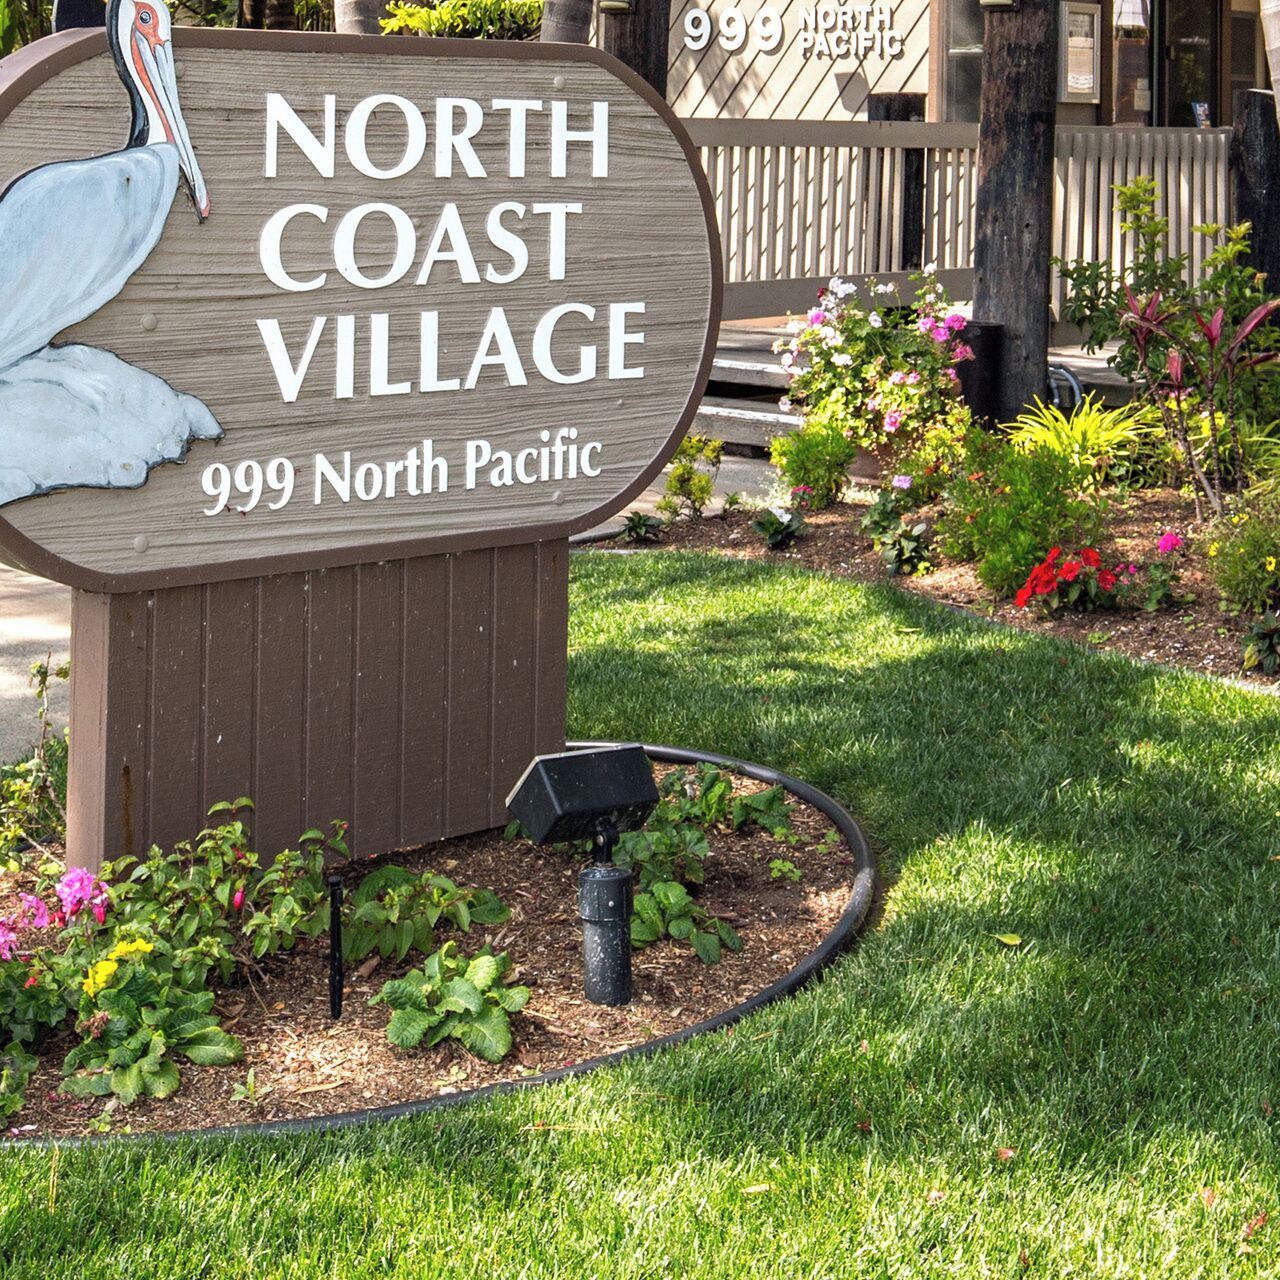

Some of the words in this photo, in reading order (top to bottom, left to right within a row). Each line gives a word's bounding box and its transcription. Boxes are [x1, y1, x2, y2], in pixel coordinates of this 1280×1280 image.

[683, 7, 782, 51] 999
[799, 7, 891, 29] NORTH
[800, 30, 902, 55] PACIFIC
[264, 93, 609, 180] NORTH
[258, 202, 583, 292] COAST
[255, 301, 646, 403] VILLAGE
[201, 457, 295, 516] 999
[314, 438, 448, 505] North
[465, 427, 602, 490] Pacific
